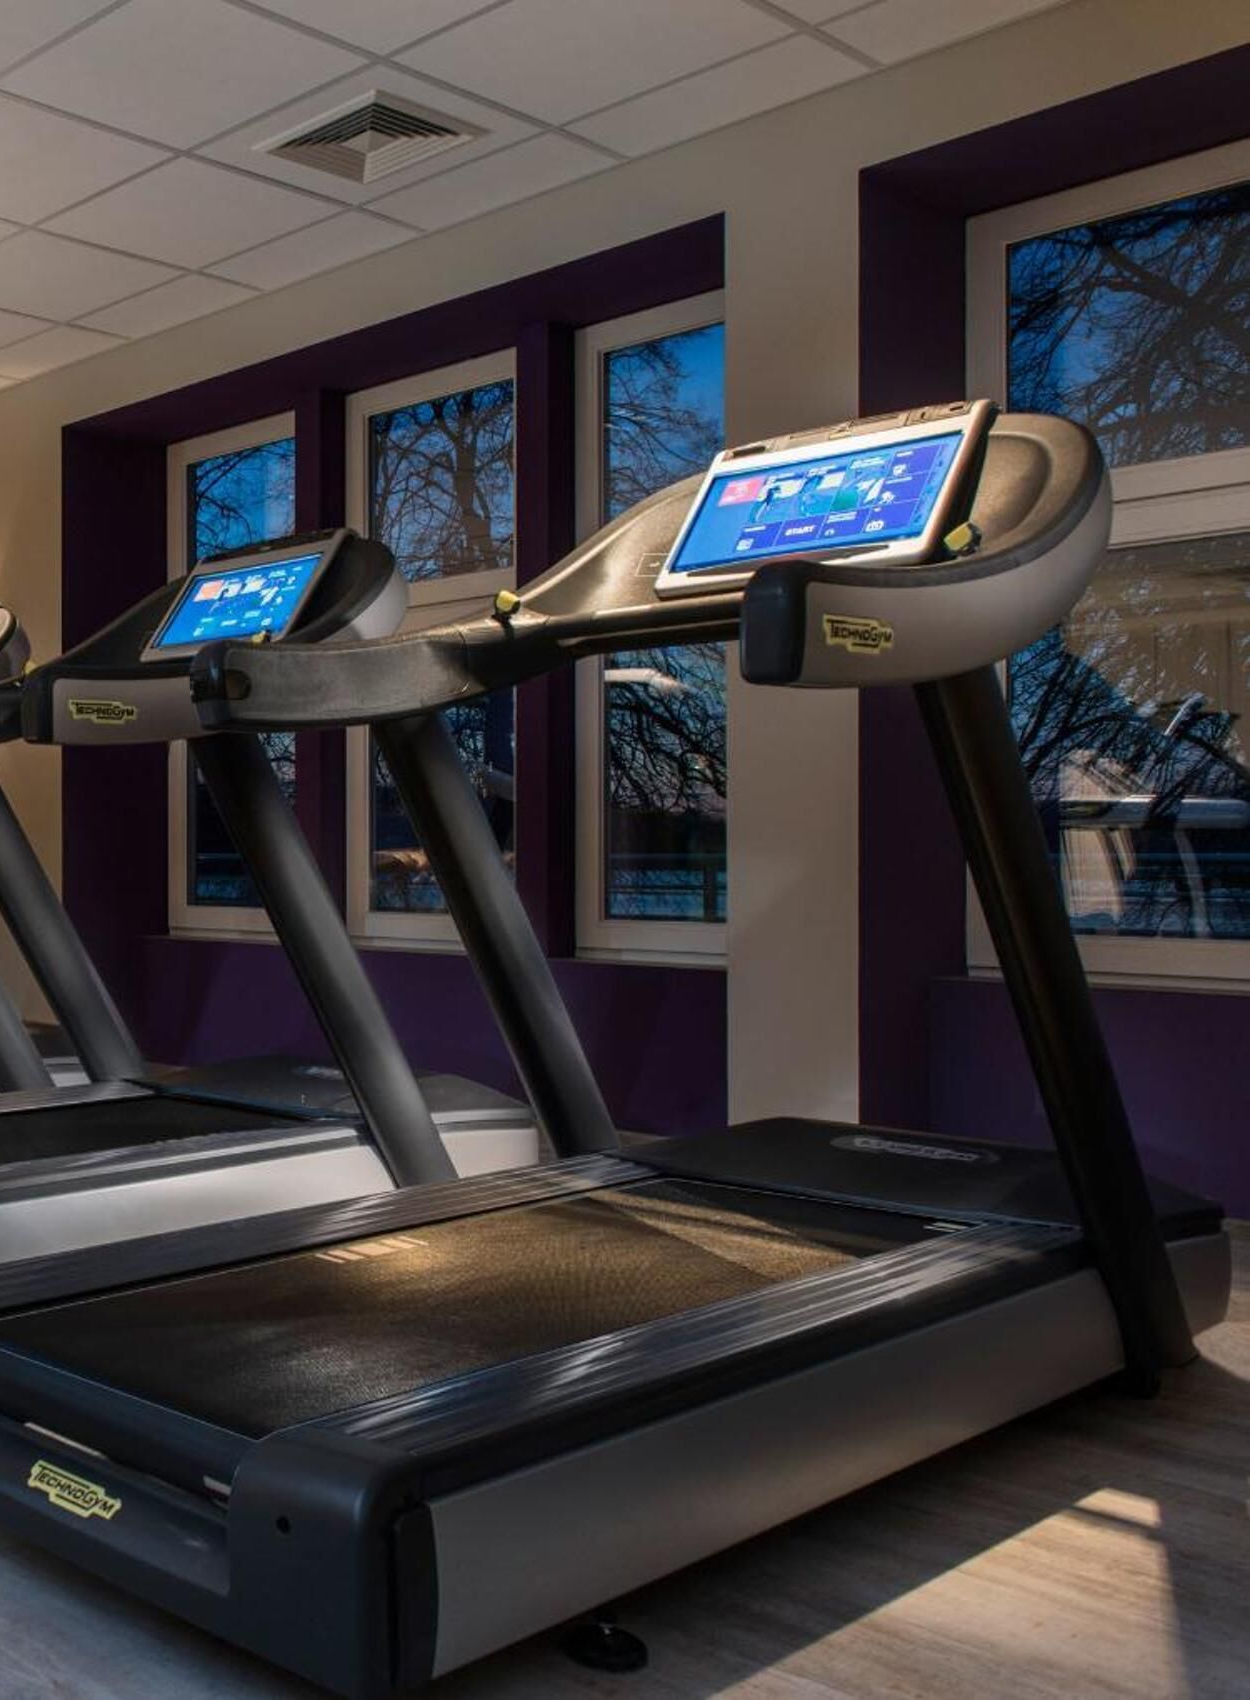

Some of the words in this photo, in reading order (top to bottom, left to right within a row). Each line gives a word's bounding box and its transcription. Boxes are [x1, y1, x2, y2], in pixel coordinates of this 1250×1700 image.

[826, 618, 893, 648] TECHNOGYM
[71, 702, 134, 720] TECHNOGYM
[33, 1463, 115, 1515] TECHNOGYM
